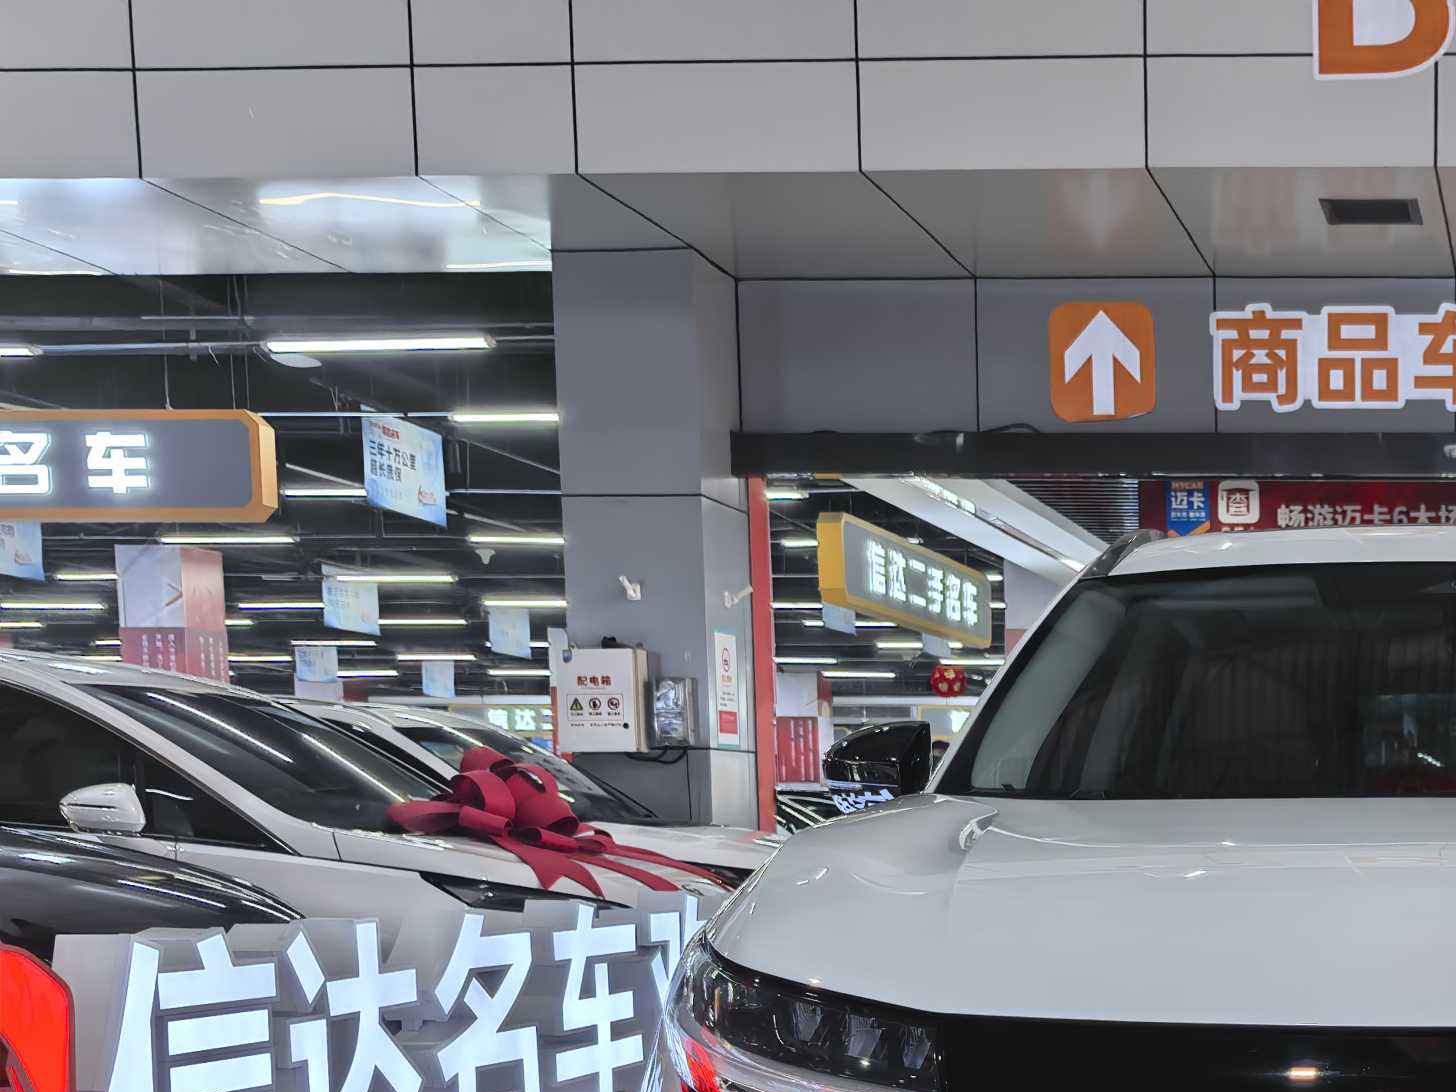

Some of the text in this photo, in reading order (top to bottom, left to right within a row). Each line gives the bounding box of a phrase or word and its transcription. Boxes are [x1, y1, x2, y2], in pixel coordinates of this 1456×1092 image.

[0, 429, 151, 496] 名车
[1171, 491, 1205, 509] 迈卡
[865, 538, 979, 628] 信达二手名车
[576, 675, 612, 688] 配电箱
